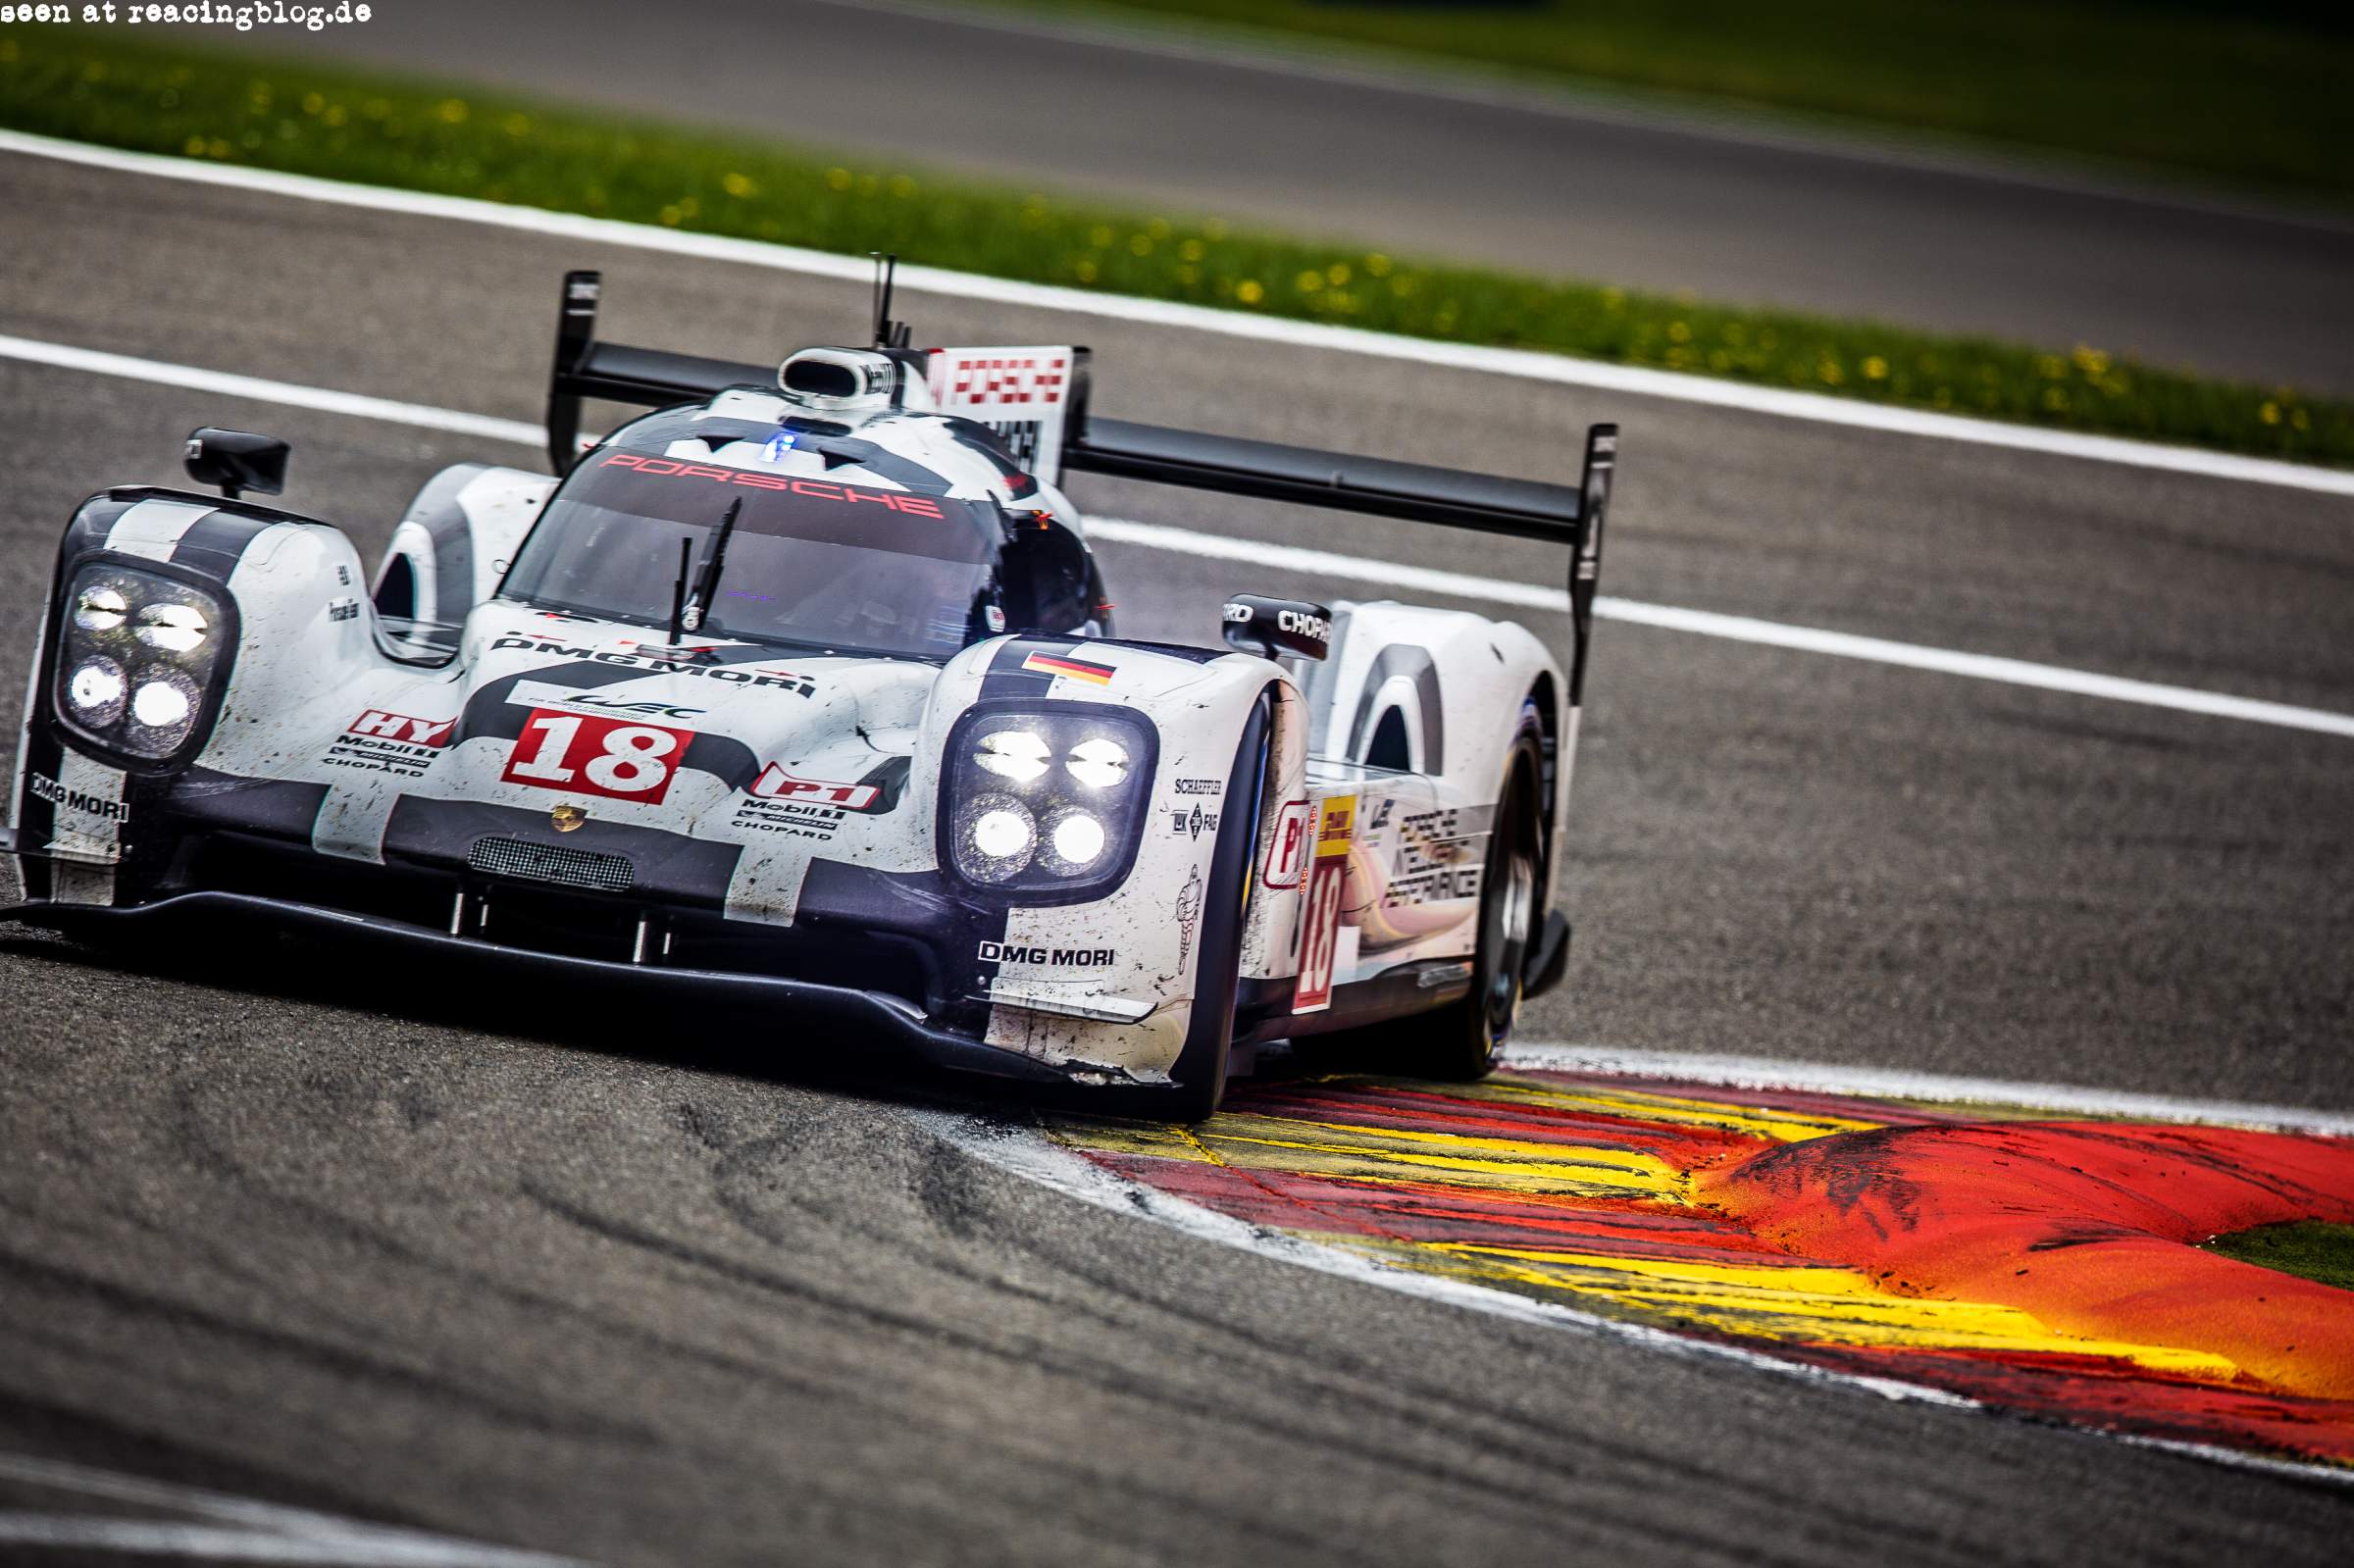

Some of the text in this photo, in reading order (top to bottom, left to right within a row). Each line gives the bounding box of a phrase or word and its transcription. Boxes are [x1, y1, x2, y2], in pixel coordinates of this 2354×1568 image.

[600, 454, 945, 520] PORSCHE
[490, 637, 816, 699] DMG MORI
[353, 711, 456, 743] HY
[335, 734, 412, 754] Mobil
[511, 716, 678, 792] 18
[322, 758, 425, 778] CHOPARD
[776, 781, 855, 802] P1
[68, 790, 128, 821] MORI
[742, 799, 817, 817] Mobil
[731, 820, 833, 840] CHOPARD
[767, 813, 837, 830] MICHELIN
[1300, 867, 1342, 993] 18
[979, 941, 1114, 966] DMG MORI
